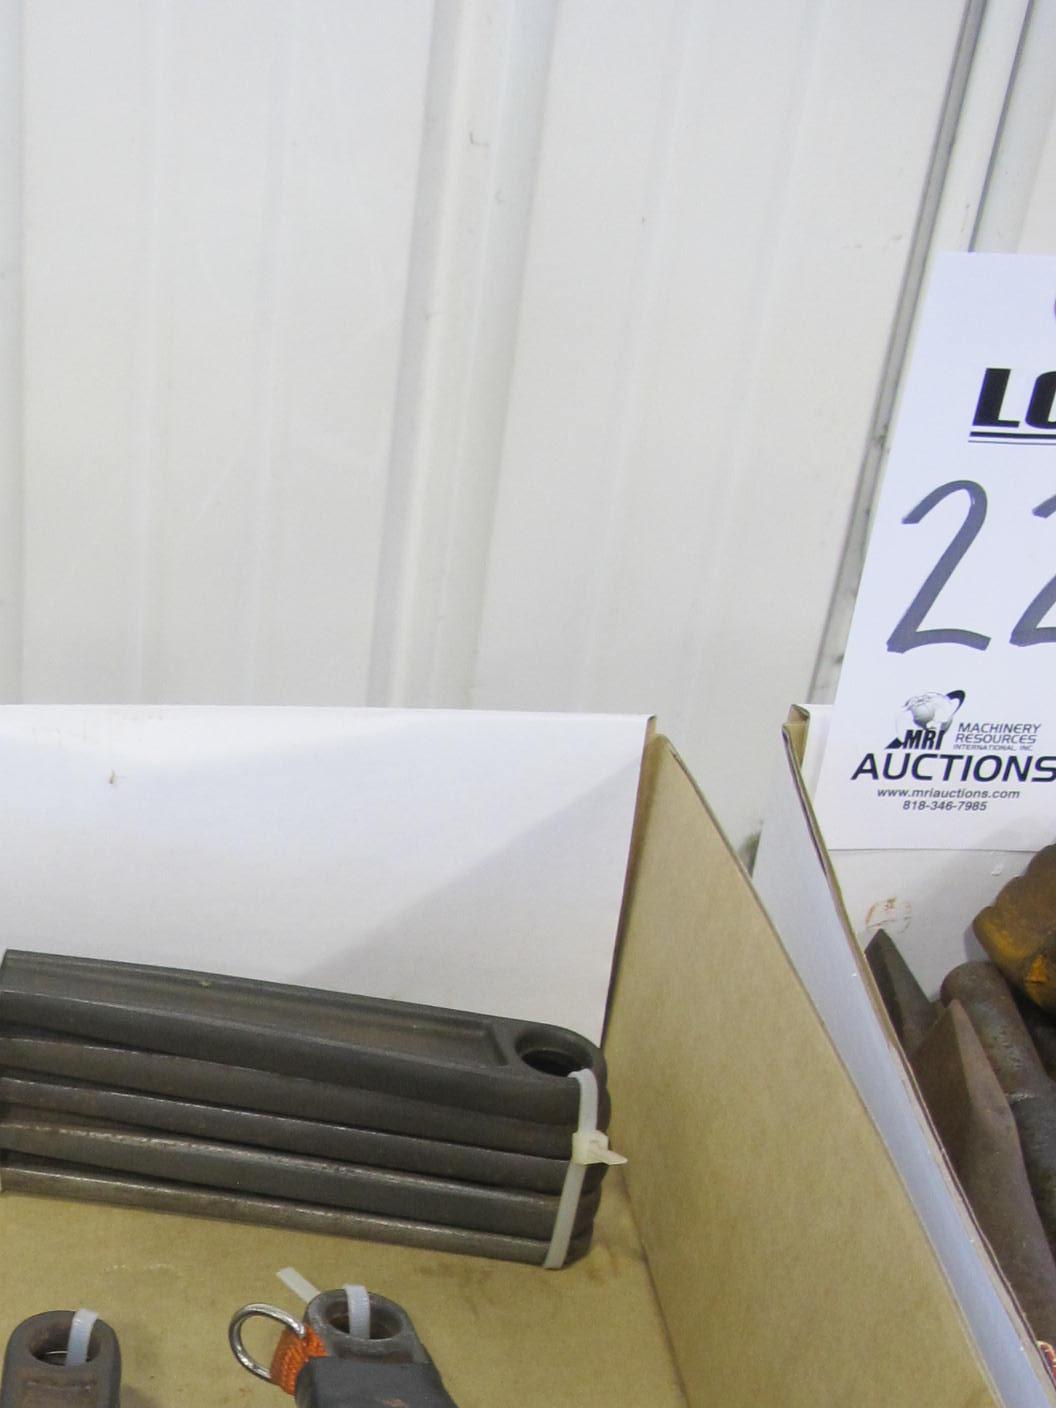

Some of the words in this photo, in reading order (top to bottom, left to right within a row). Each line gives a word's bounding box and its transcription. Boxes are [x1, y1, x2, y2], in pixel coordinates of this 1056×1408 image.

[957, 723, 1042, 734] MACHINERY
[901, 729, 945, 750] MRI
[955, 734, 1037, 744] RESOURCES
[850, 752, 1056, 782] AUCTIONS
[877, 788, 1021, 799] www.mriauctions.com
[902, 800, 987, 811] 818-346-7985
